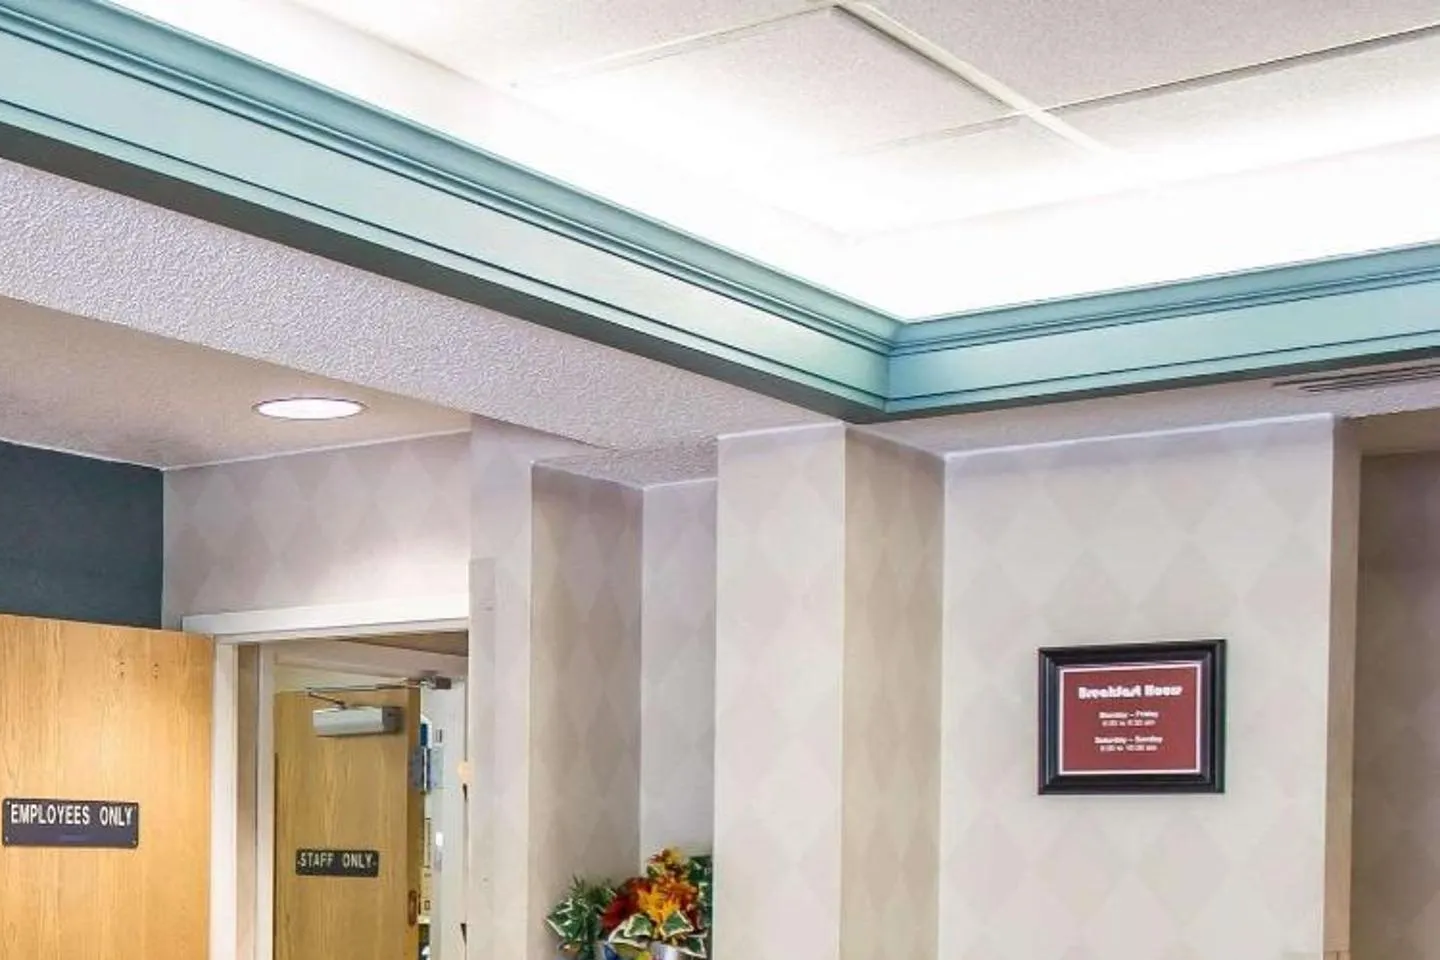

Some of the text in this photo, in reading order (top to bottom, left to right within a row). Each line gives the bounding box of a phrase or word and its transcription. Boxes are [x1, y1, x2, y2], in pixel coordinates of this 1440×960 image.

[1078, 684, 1141, 699] Breakfast
[10, 803, 134, 827] EMPLOYEES ONLY
[300, 852, 373, 869] STAFF ONLY
